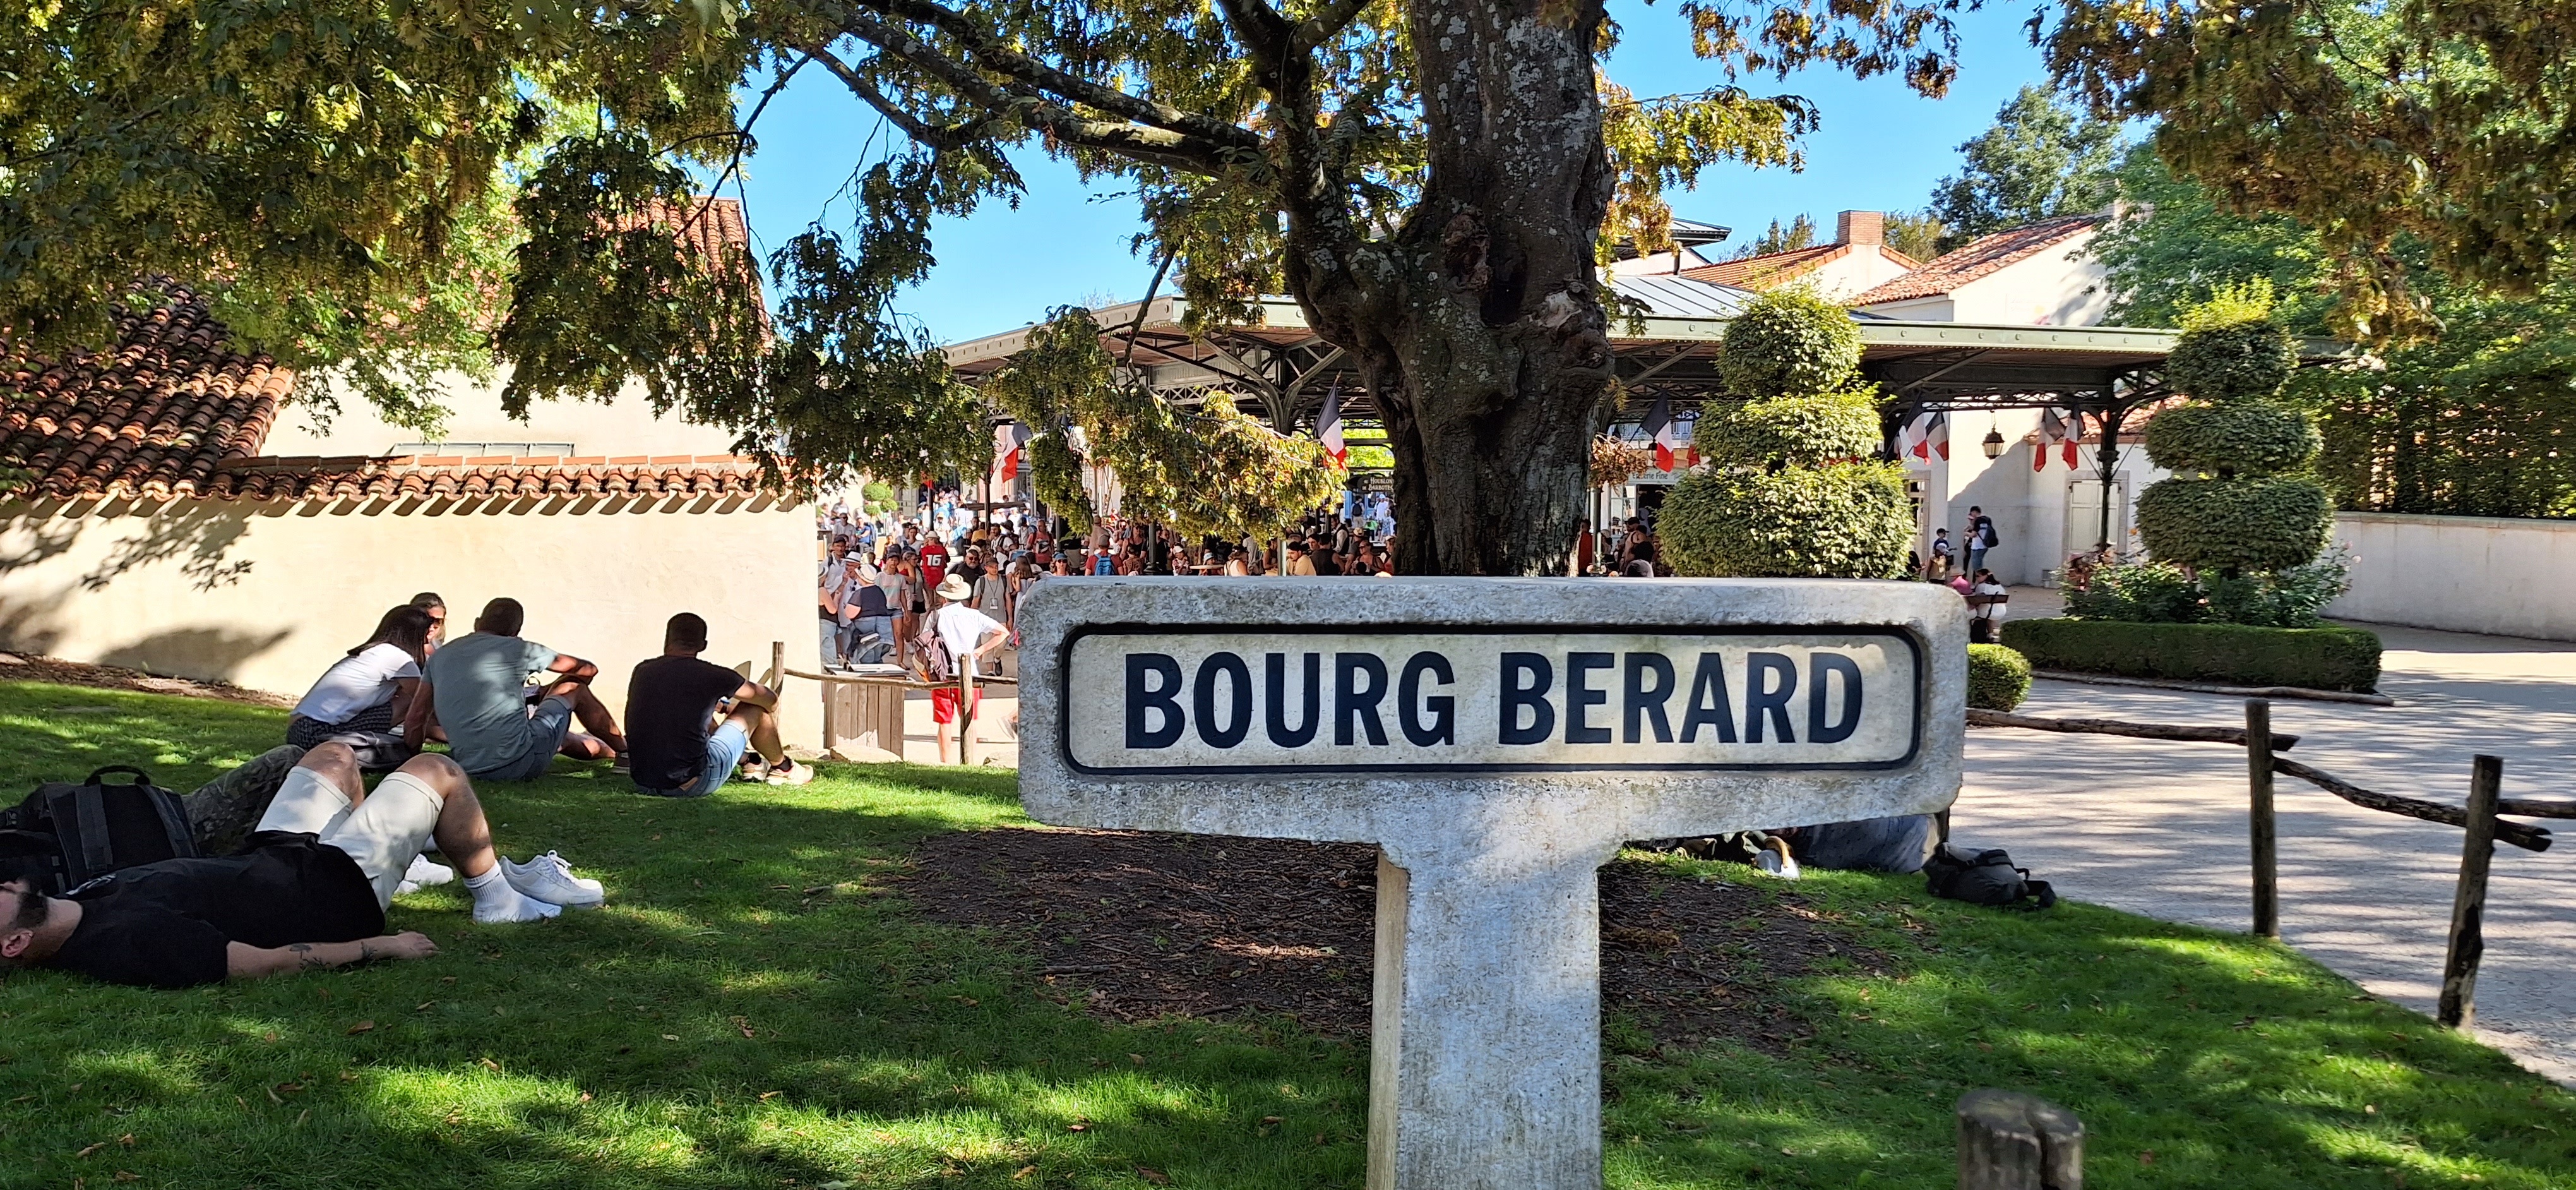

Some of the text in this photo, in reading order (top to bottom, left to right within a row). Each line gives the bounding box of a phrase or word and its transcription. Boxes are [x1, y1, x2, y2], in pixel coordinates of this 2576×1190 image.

[1656, 471, 1668, 479] Fine
[926, 555, 942, 566] 16
[1124, 651, 1863, 749] BOURG BERARD
